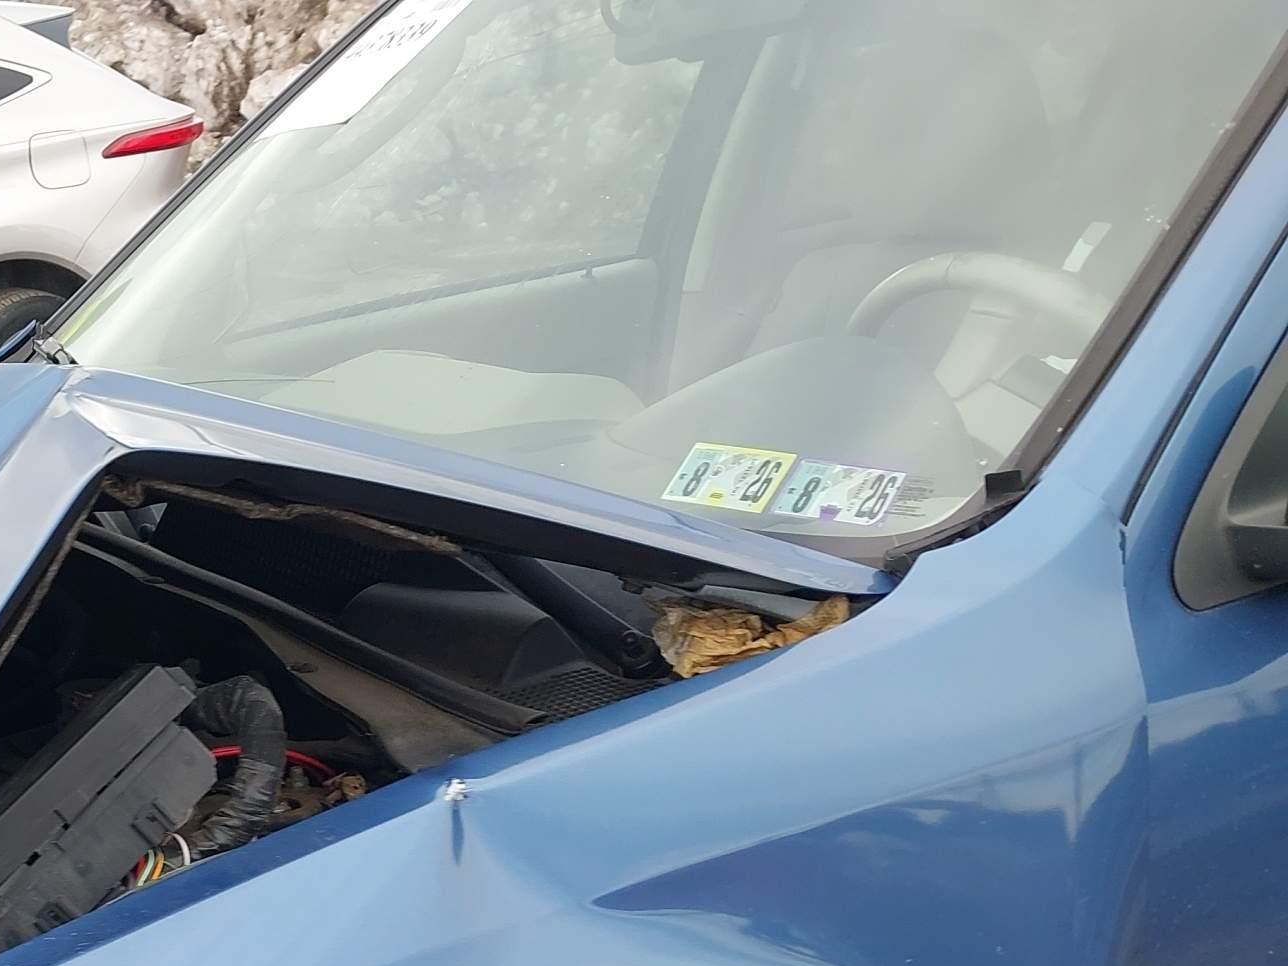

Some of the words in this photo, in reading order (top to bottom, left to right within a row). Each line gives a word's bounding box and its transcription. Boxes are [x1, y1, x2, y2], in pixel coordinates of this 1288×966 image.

[683, 461, 711, 497] 8
[739, 459, 783, 503] 26
[792, 477, 821, 513] 8
[854, 474, 897, 520] 26
